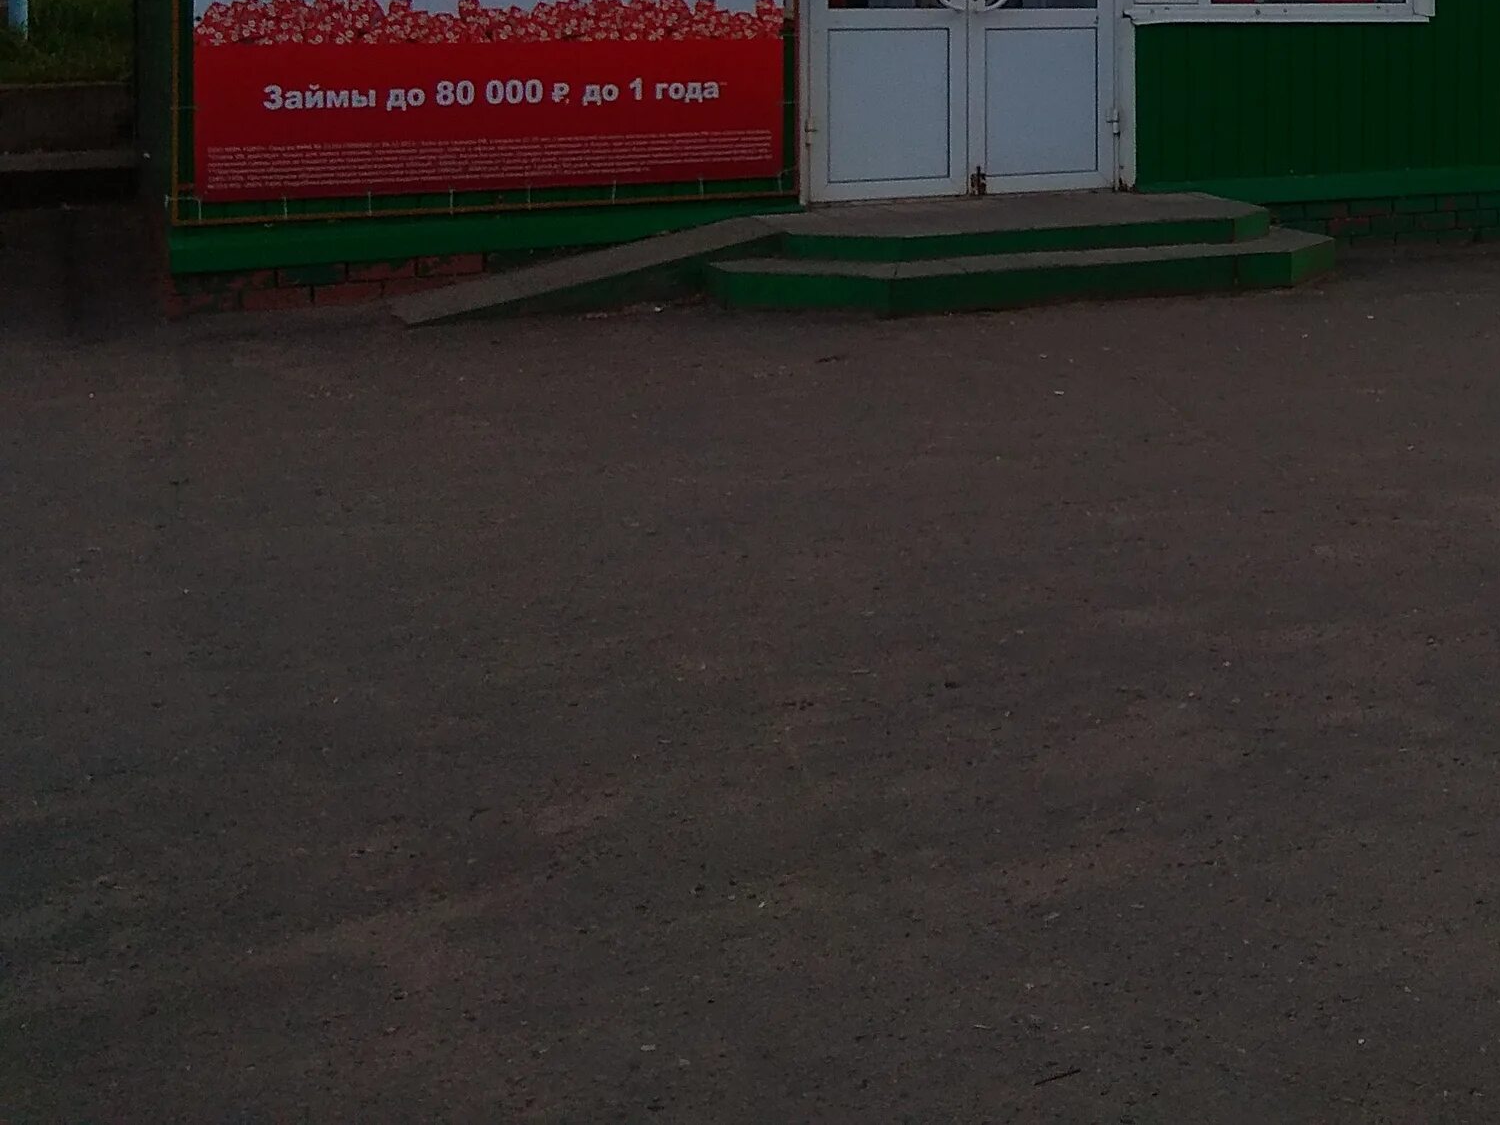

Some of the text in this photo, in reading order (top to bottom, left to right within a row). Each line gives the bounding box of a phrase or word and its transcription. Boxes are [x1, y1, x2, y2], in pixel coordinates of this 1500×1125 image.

[263, 83, 377, 111] Займы
[386, 88, 425, 112] до
[436, 80, 475, 106] 80
[486, 78, 543, 105] 000
[582, 84, 619, 106] до
[629, 77, 643, 100] 1
[655, 80, 721, 104] года
